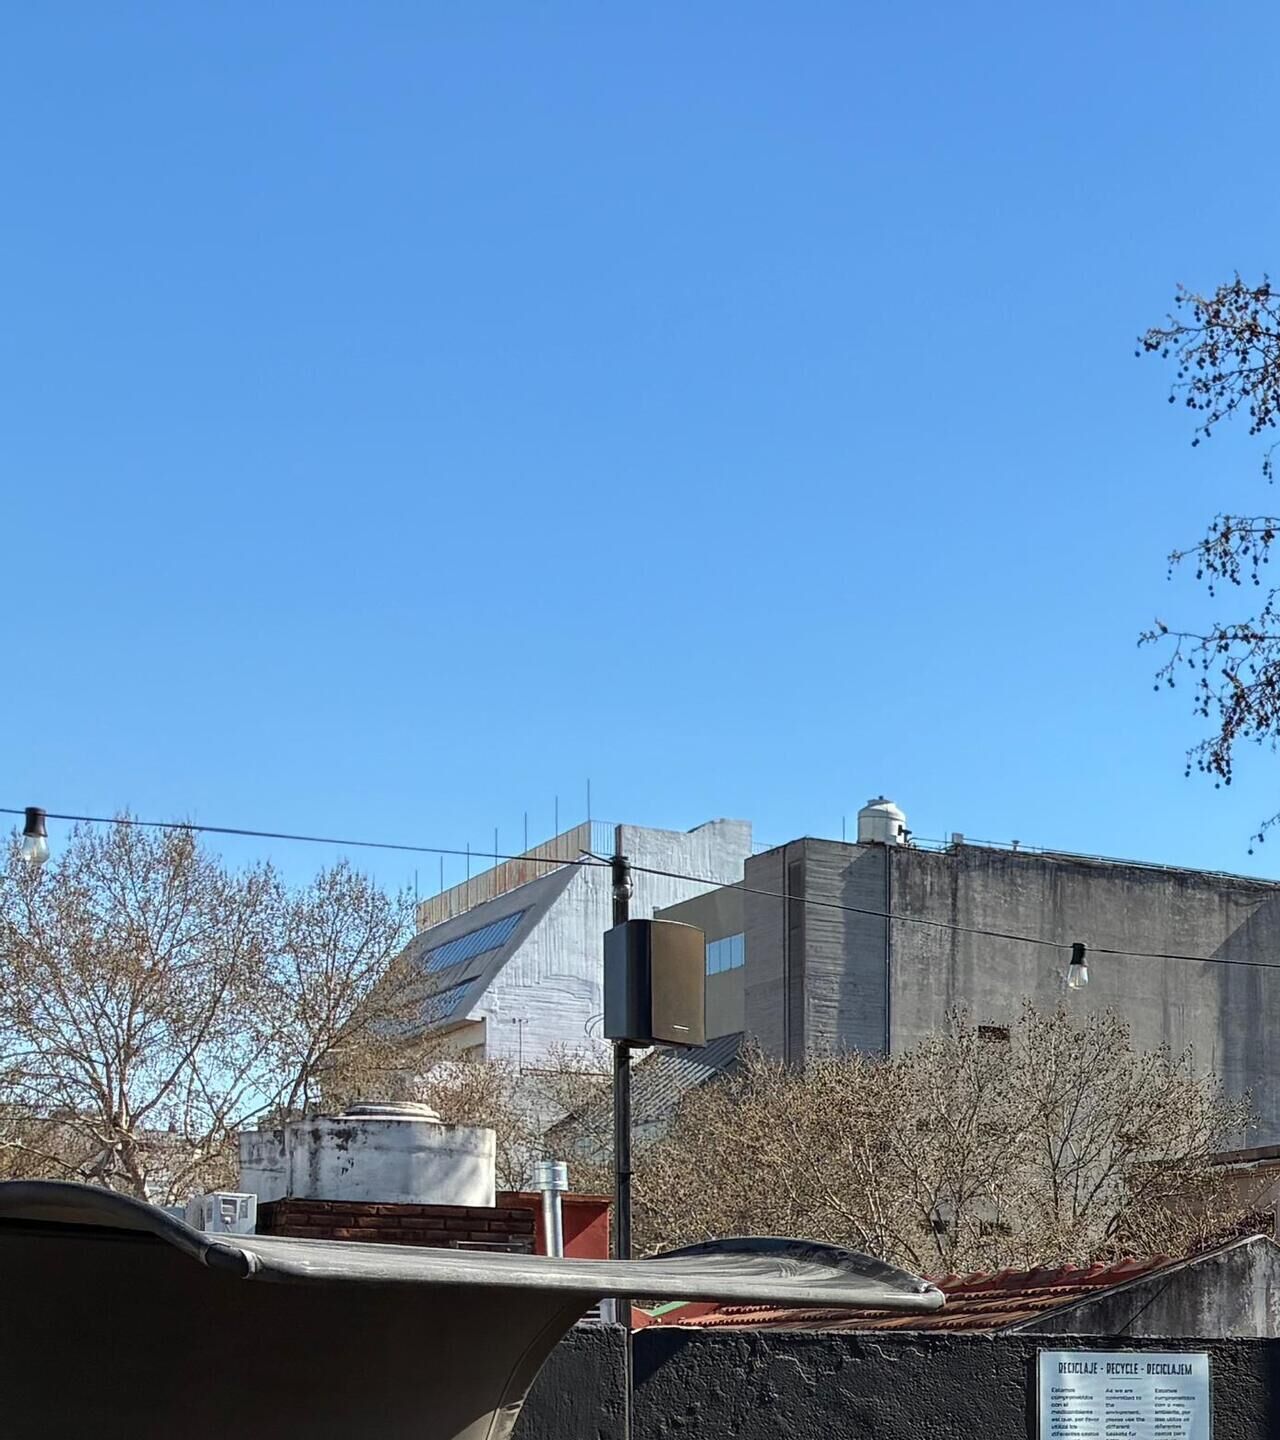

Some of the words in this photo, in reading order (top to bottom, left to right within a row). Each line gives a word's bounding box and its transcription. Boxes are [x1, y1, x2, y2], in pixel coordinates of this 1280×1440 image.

[1058, 1362, 1098, 1375] RECICLAJE
[1106, 1363, 1139, 1375] RECYCLE
[1146, 1363, 1193, 1376] RECICLAJEM
